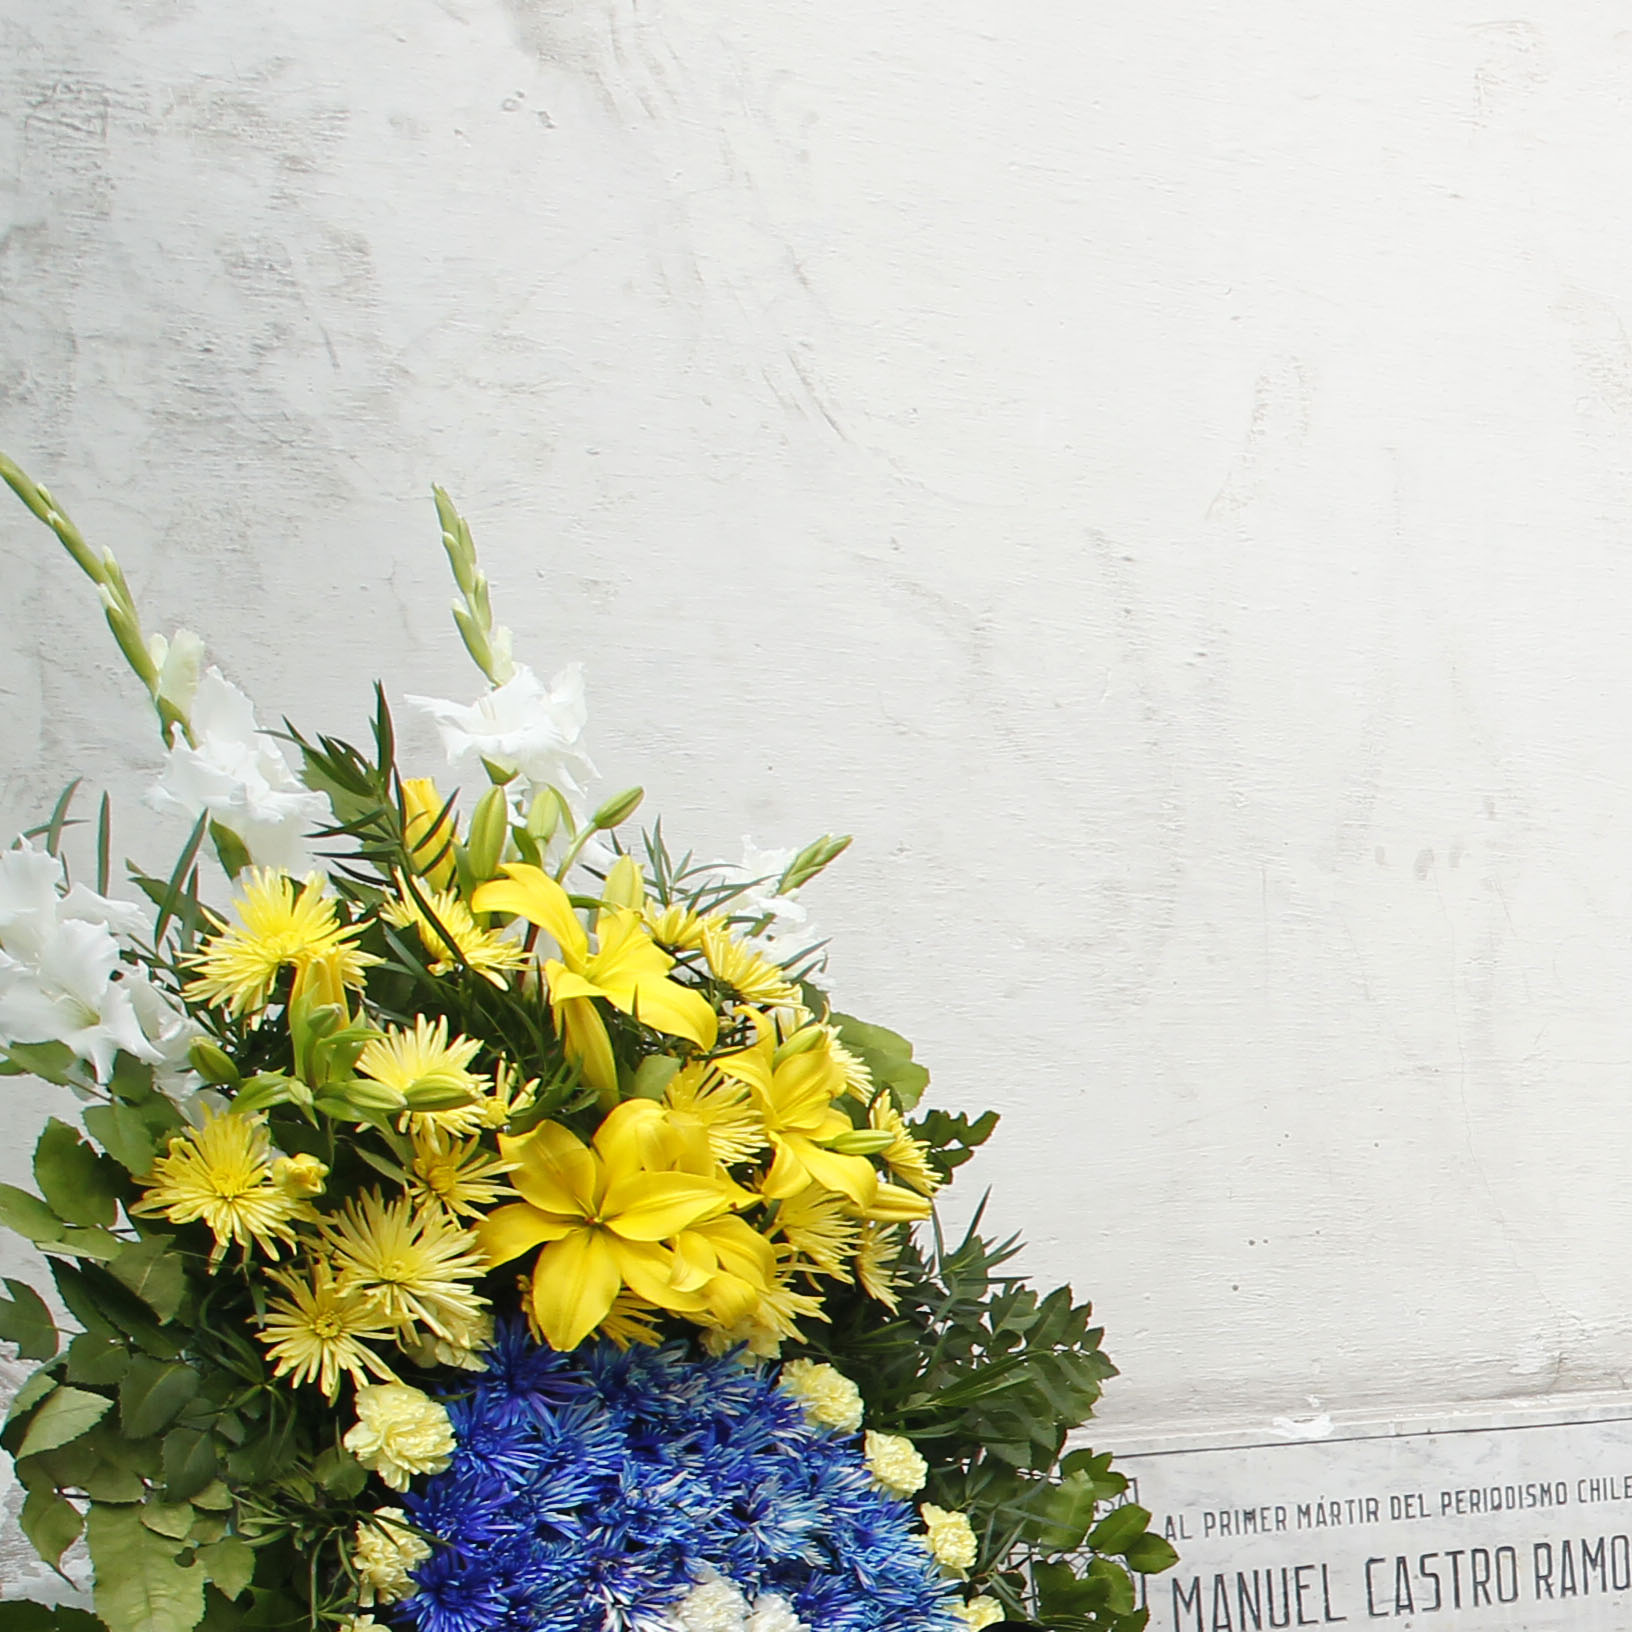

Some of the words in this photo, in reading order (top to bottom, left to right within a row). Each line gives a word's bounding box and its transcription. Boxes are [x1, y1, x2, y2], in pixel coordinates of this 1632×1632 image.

[1164, 1513, 1193, 1542] AL
[1203, 1505, 1289, 1539] PRIMER
[1296, 1494, 1380, 1530] MÁRTIR
[1389, 1492, 1432, 1521] DEL
[1440, 1481, 1568, 1518] PERIODISMO
[1364, 1544, 1519, 1618] CASTRO
